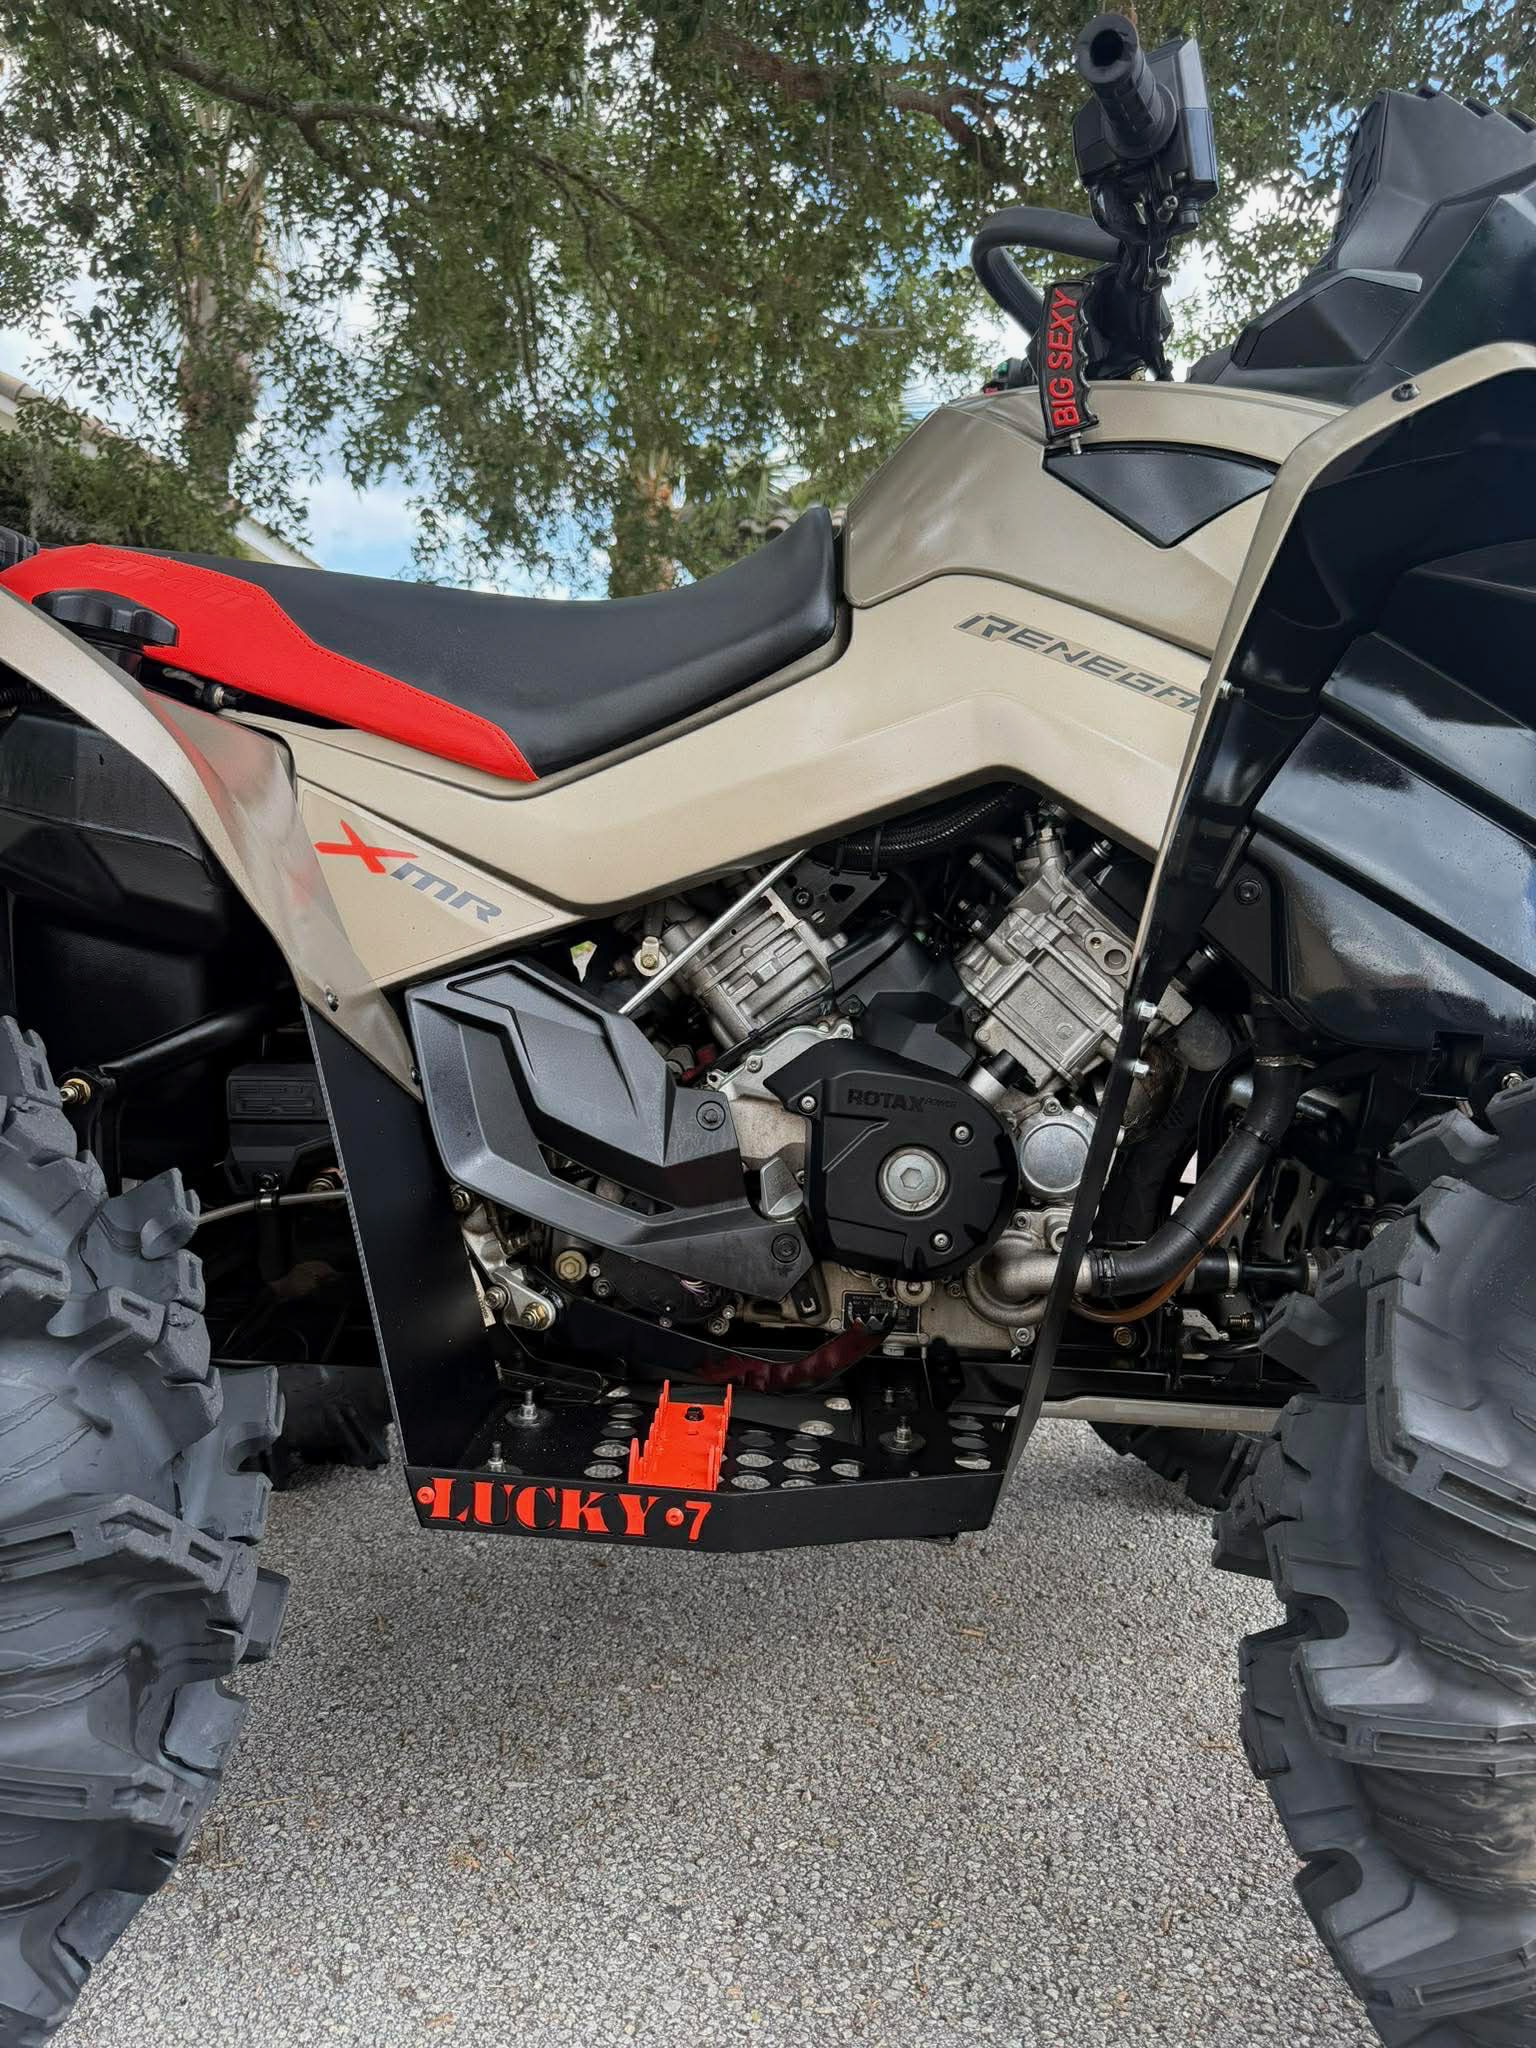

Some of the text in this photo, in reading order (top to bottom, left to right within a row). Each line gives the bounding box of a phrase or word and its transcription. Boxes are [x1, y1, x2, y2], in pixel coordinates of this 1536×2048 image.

[1046, 287, 1081, 428] BIG SEXY
[954, 612, 1200, 715] RENEGA
[847, 1088, 925, 1113] ROTAX
[426, 1476, 712, 1542] LUCKY 7
